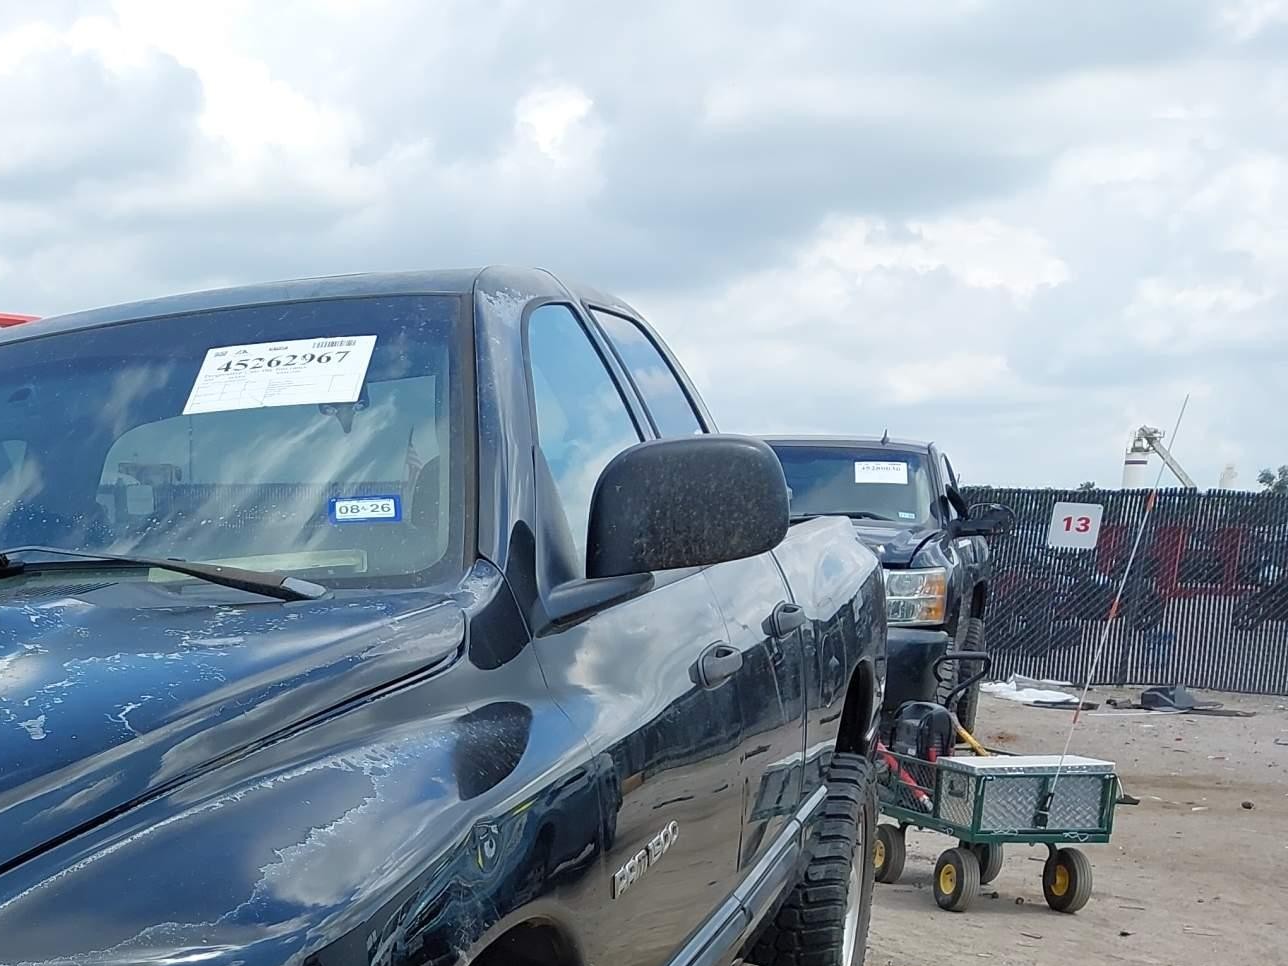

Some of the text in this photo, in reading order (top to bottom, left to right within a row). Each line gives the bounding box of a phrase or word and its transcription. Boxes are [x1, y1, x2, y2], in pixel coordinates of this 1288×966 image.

[216, 349, 353, 373] 45262967
[338, 503, 392, 515] 08 26
[1062, 516, 1092, 533] 13
